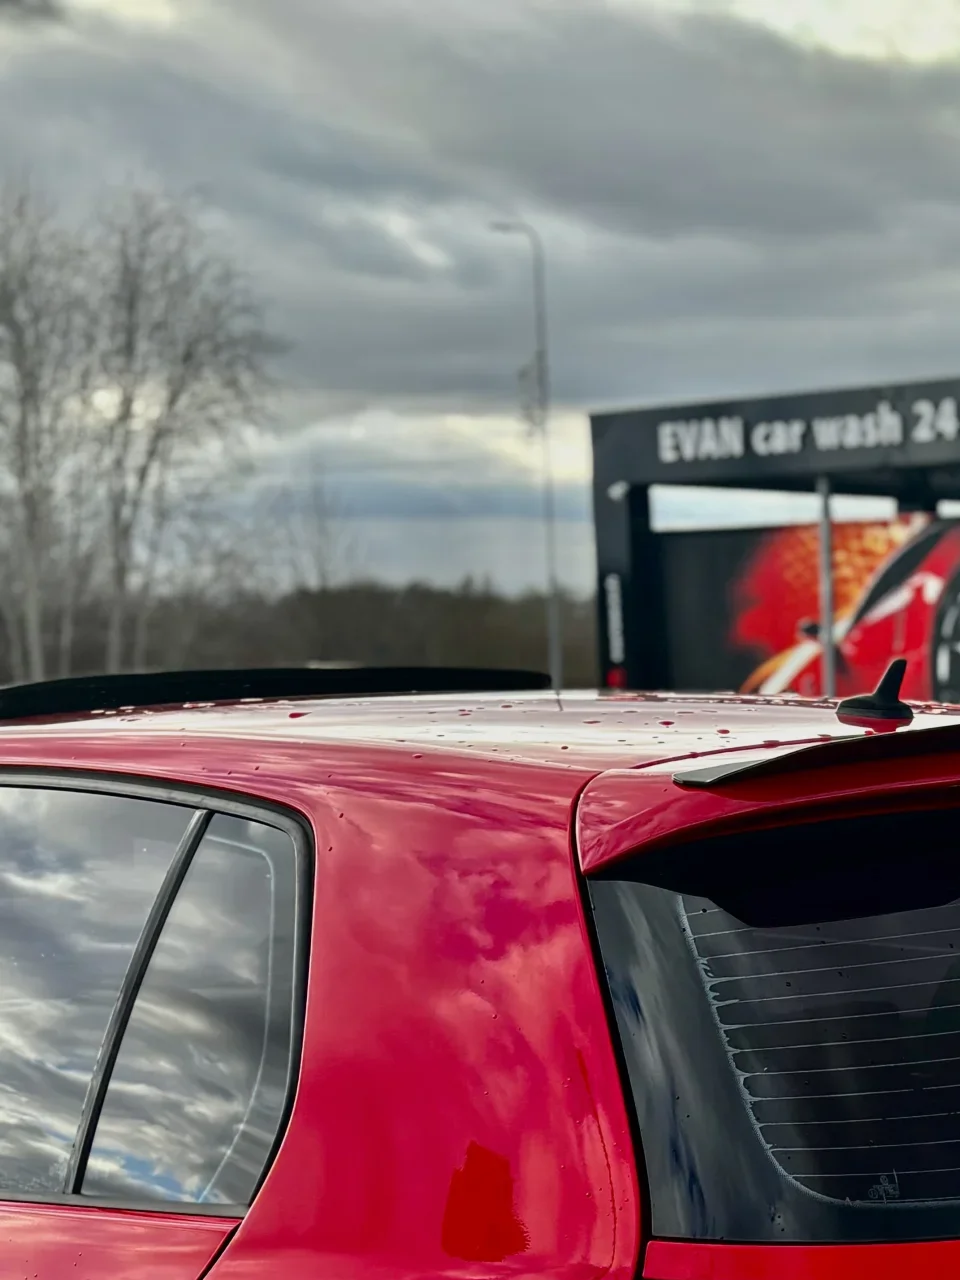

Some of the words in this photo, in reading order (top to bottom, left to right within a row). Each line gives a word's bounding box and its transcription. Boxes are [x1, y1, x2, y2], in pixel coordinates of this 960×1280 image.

[657, 416, 745, 463] EVAN
[750, 419, 806, 456] car
[811, 401, 903, 451] wash
[910, 397, 960, 443] 24
